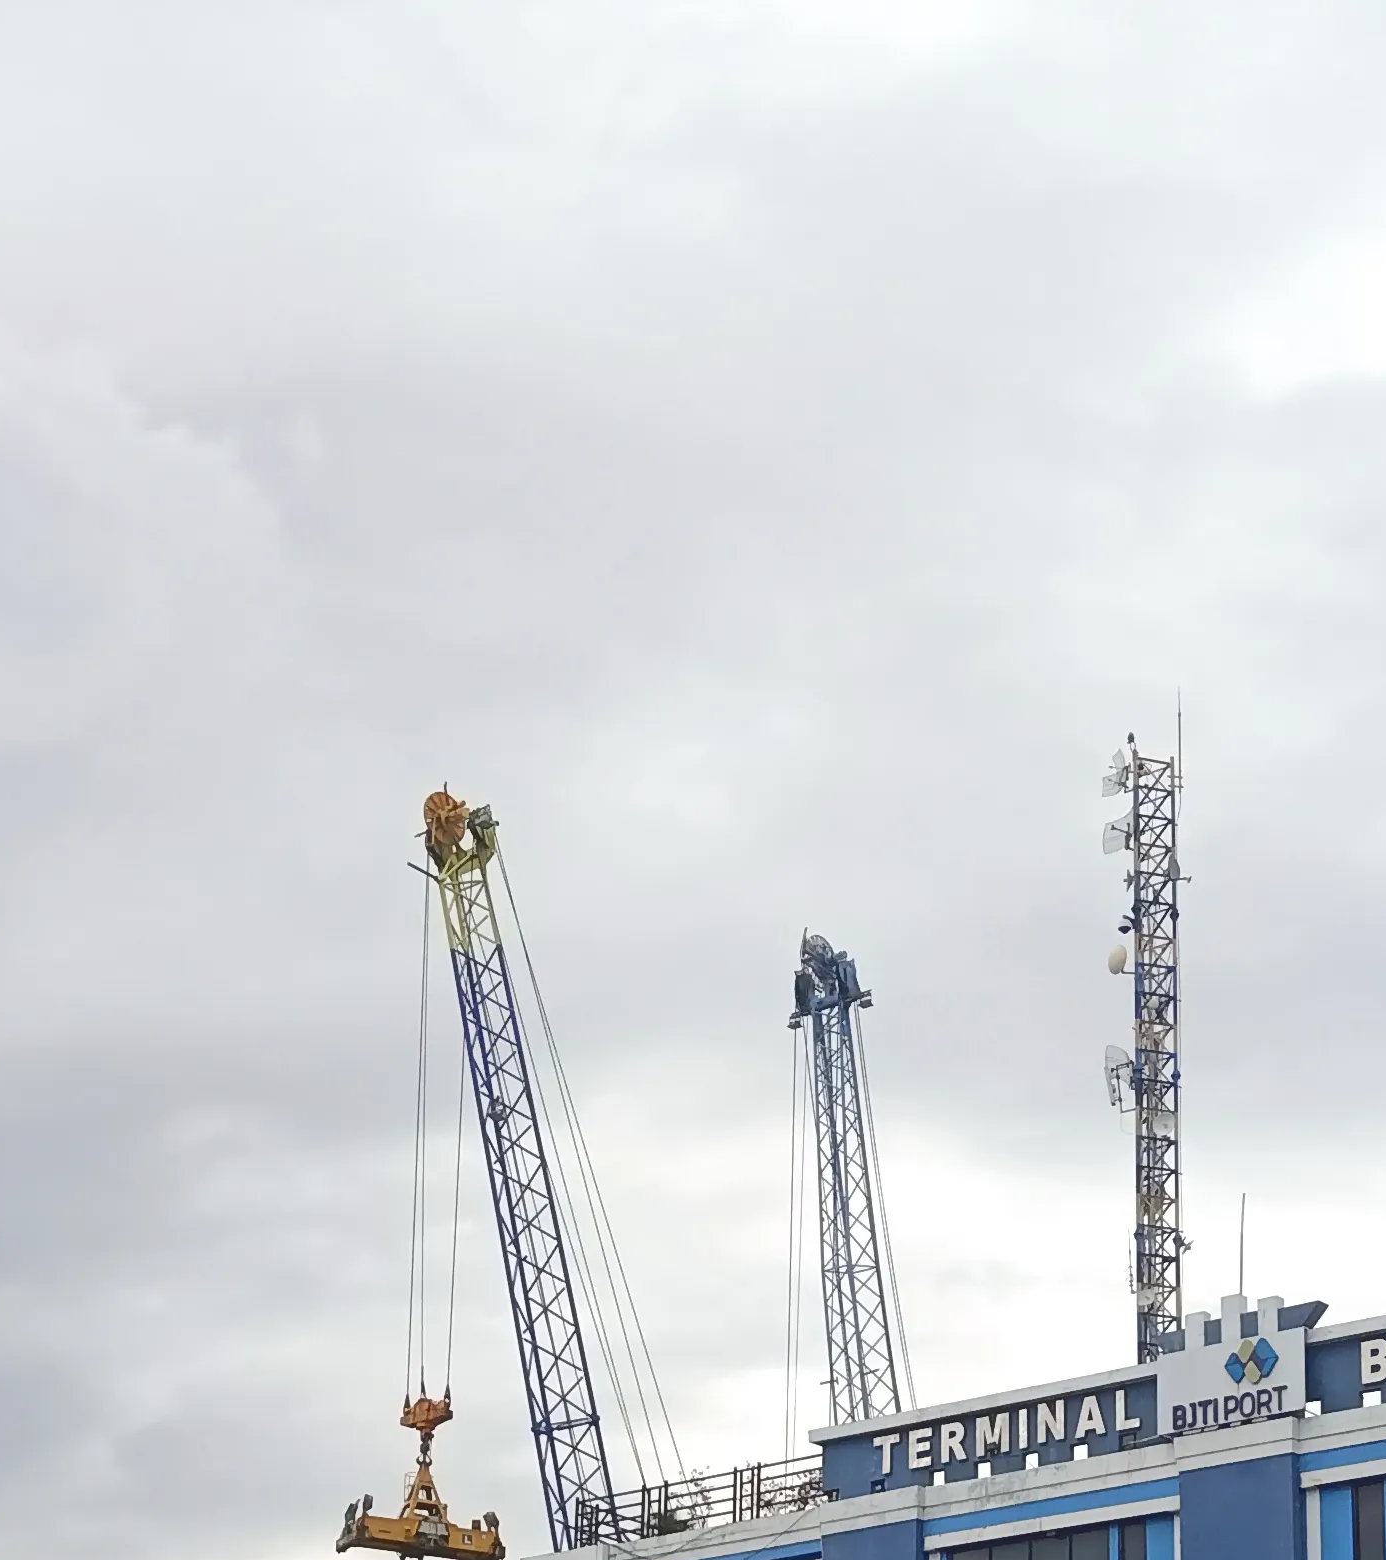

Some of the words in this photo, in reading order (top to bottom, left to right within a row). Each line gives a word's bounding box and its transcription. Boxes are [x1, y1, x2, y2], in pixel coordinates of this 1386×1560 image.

[873, 1390, 1140, 1475] TERMINAL
[1172, 1397, 1218, 1430] BJTI
[1224, 1385, 1288, 1421] PORT
